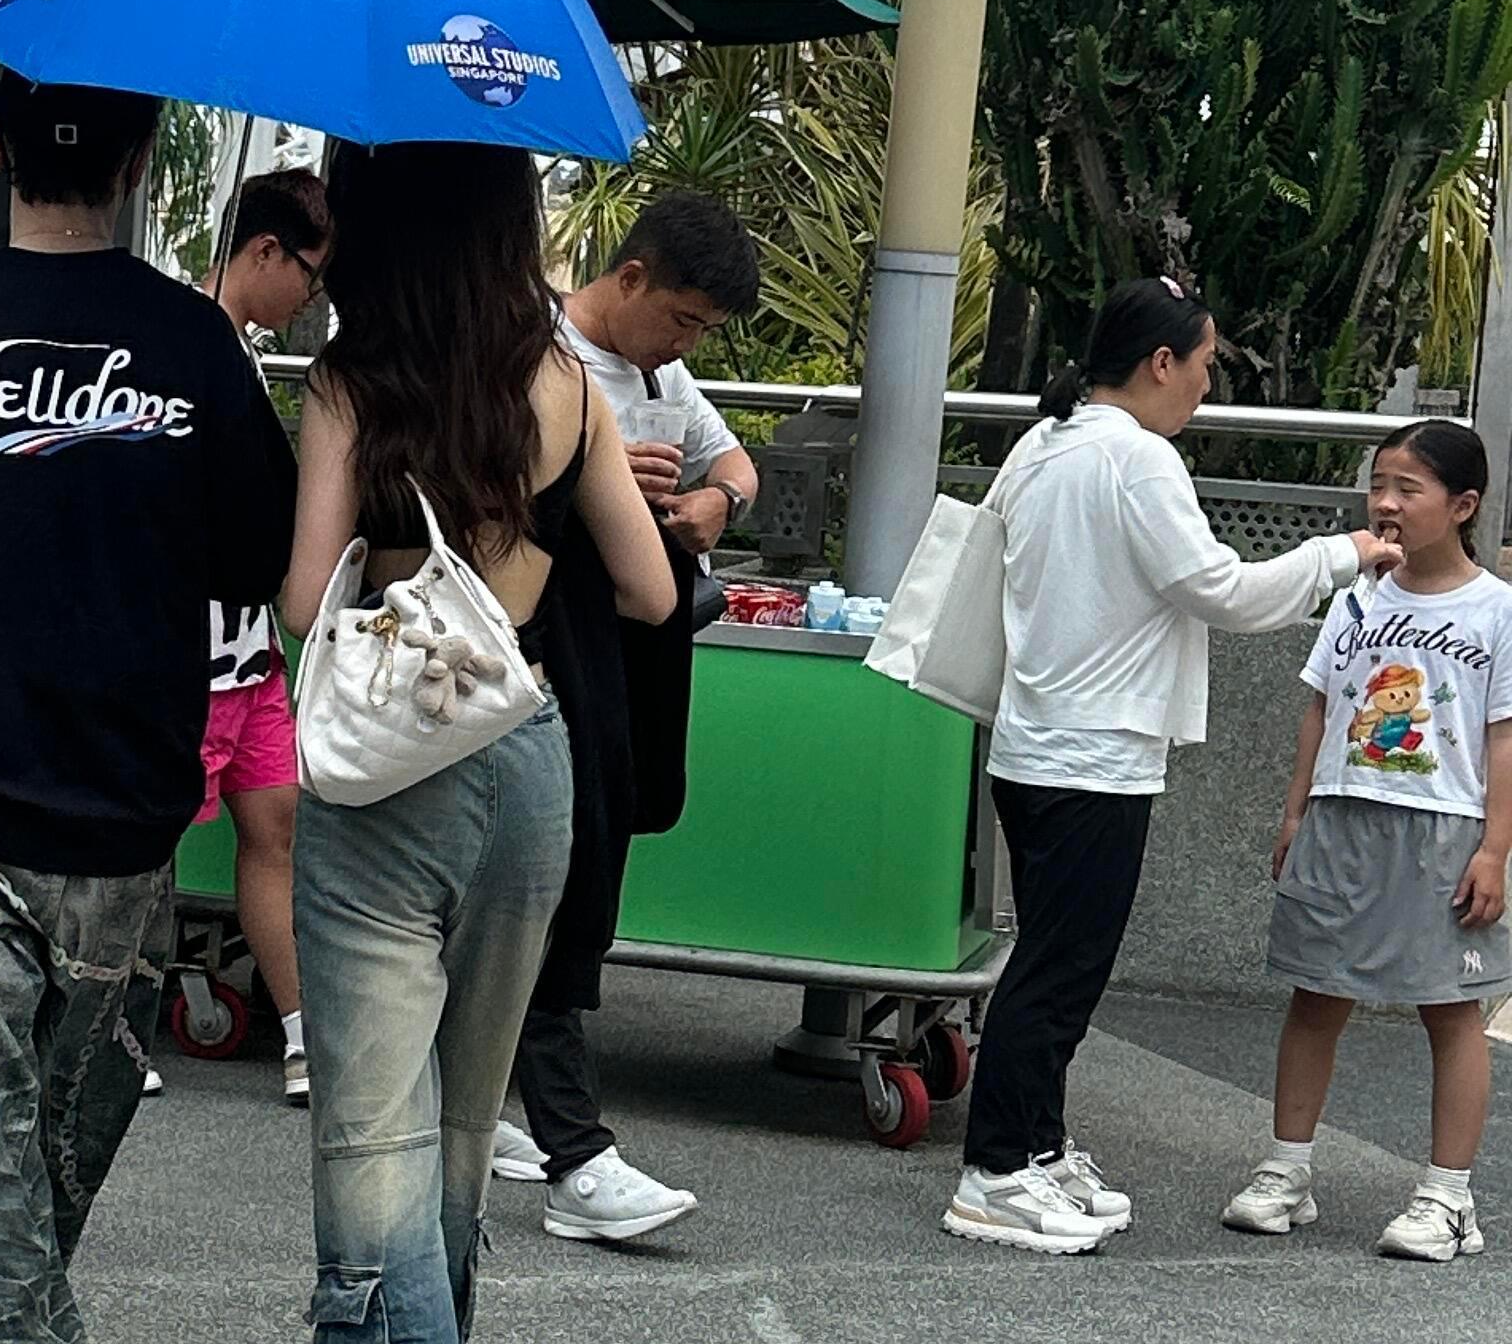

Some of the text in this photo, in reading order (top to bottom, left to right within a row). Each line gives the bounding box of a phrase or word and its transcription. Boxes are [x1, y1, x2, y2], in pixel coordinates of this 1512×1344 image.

[406, 42, 562, 81] UNIVERSAL STUDIOS
[447, 65, 528, 86] SINGAPORE
